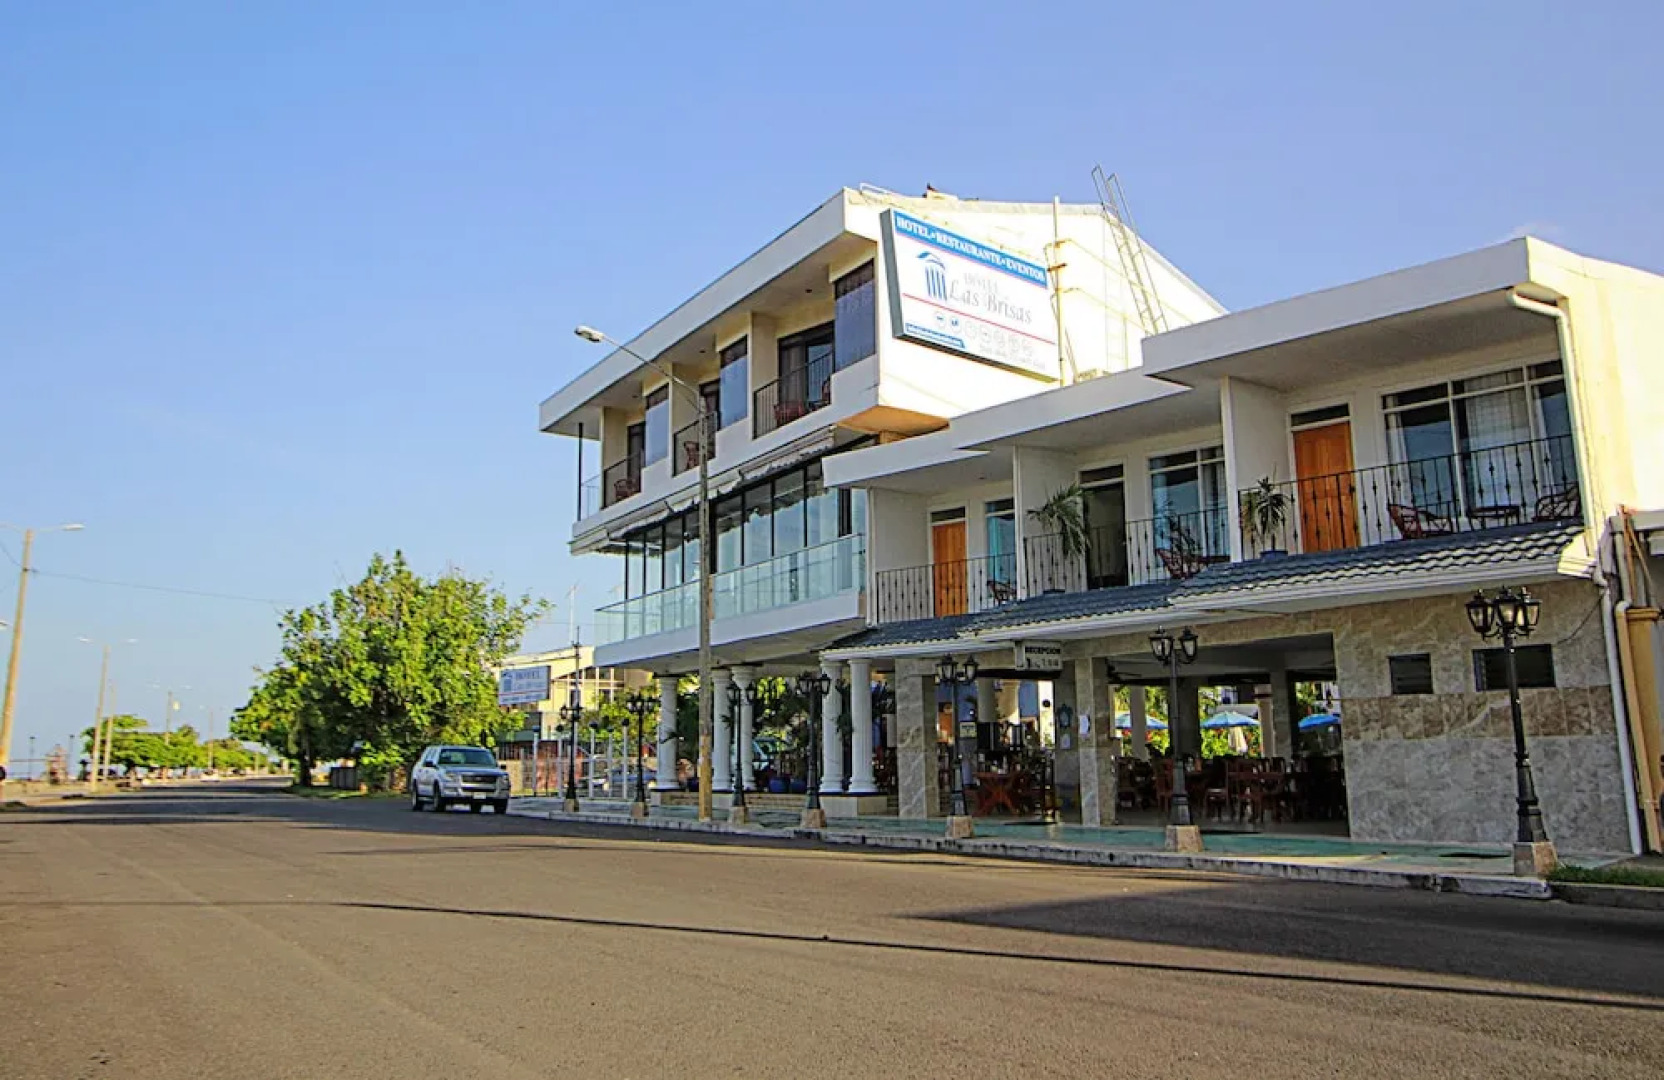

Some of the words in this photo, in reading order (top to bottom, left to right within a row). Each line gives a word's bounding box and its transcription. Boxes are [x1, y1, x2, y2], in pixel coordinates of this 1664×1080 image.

[896, 215, 931, 239] HOTEL
[949, 279, 980, 307] Las
[985, 293, 1033, 324] Brisas
